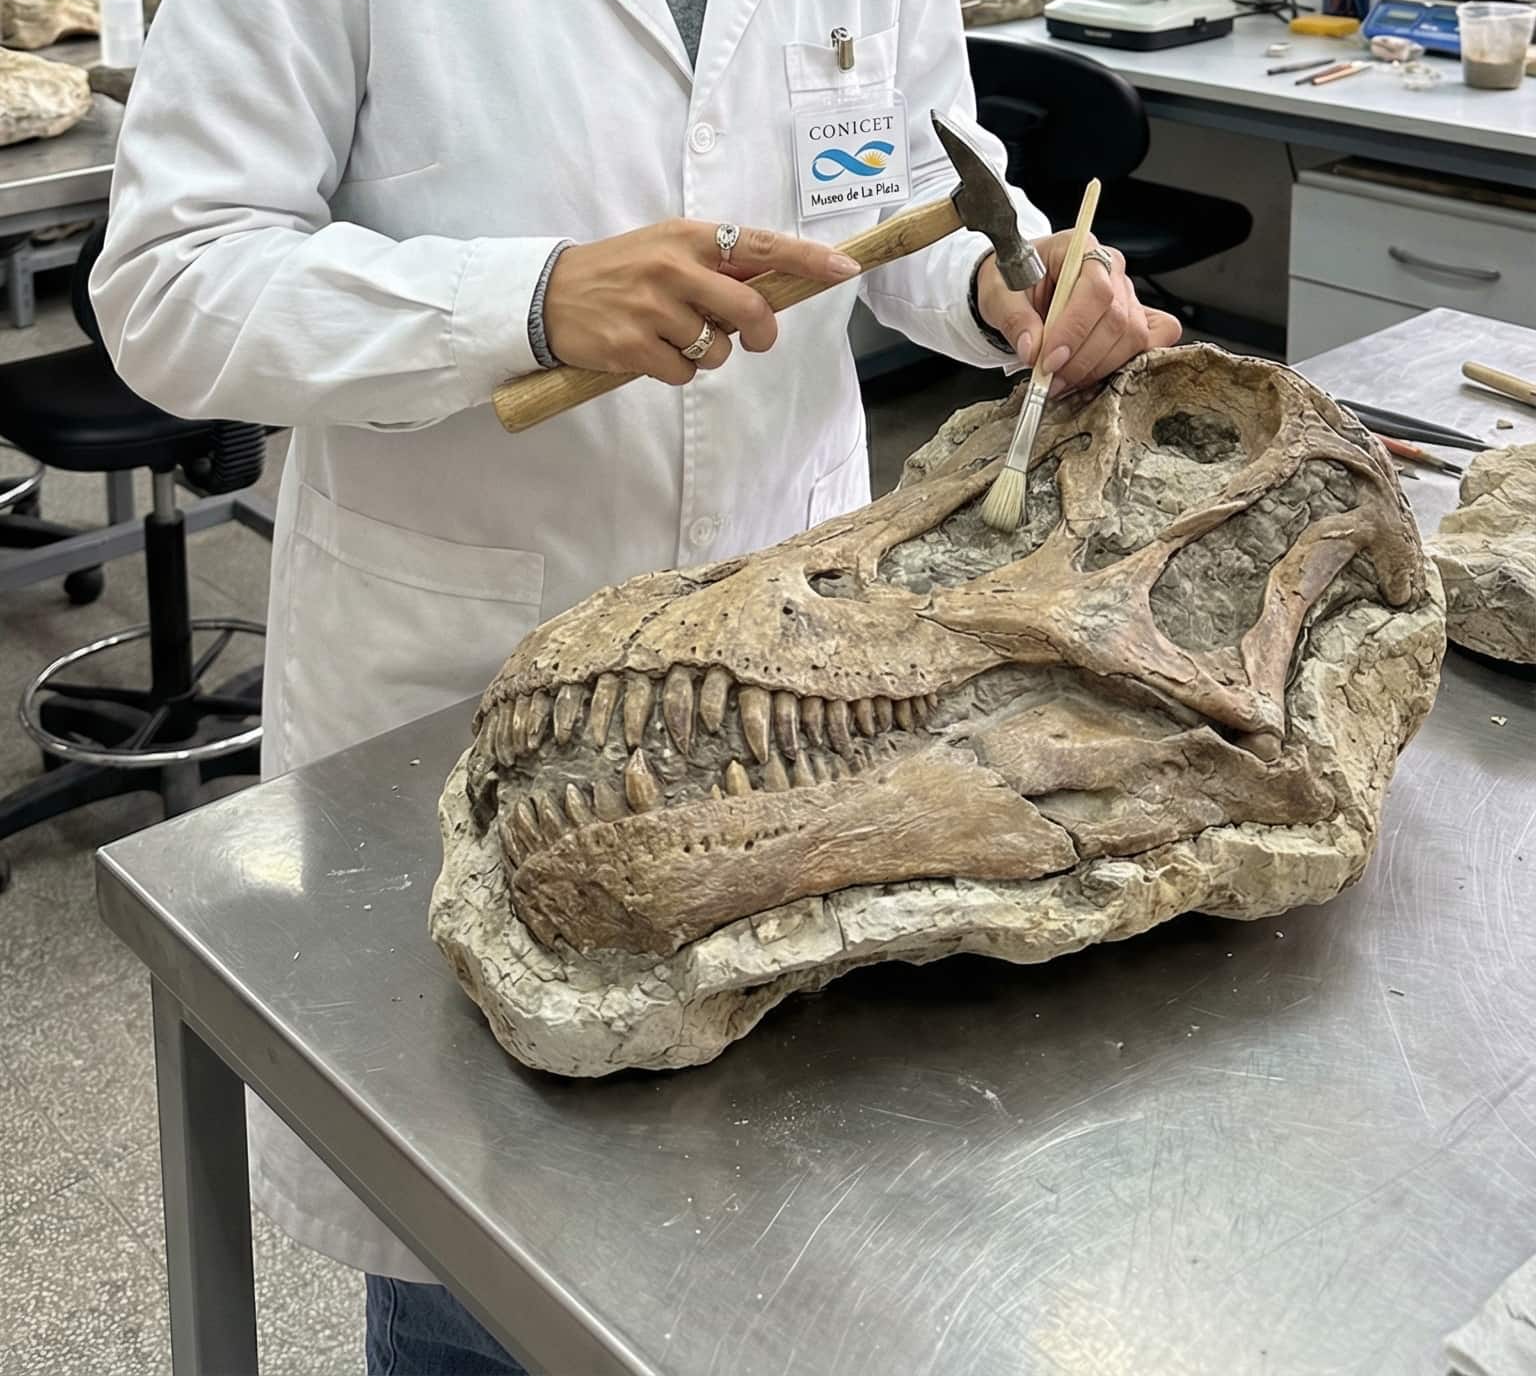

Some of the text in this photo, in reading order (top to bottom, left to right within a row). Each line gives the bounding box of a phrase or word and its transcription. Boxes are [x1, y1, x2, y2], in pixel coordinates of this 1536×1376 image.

[809, 116, 894, 140] CONICET
[811, 193, 844, 207] Museo
[847, 187, 859, 201] de
[861, 186, 873, 198] La
